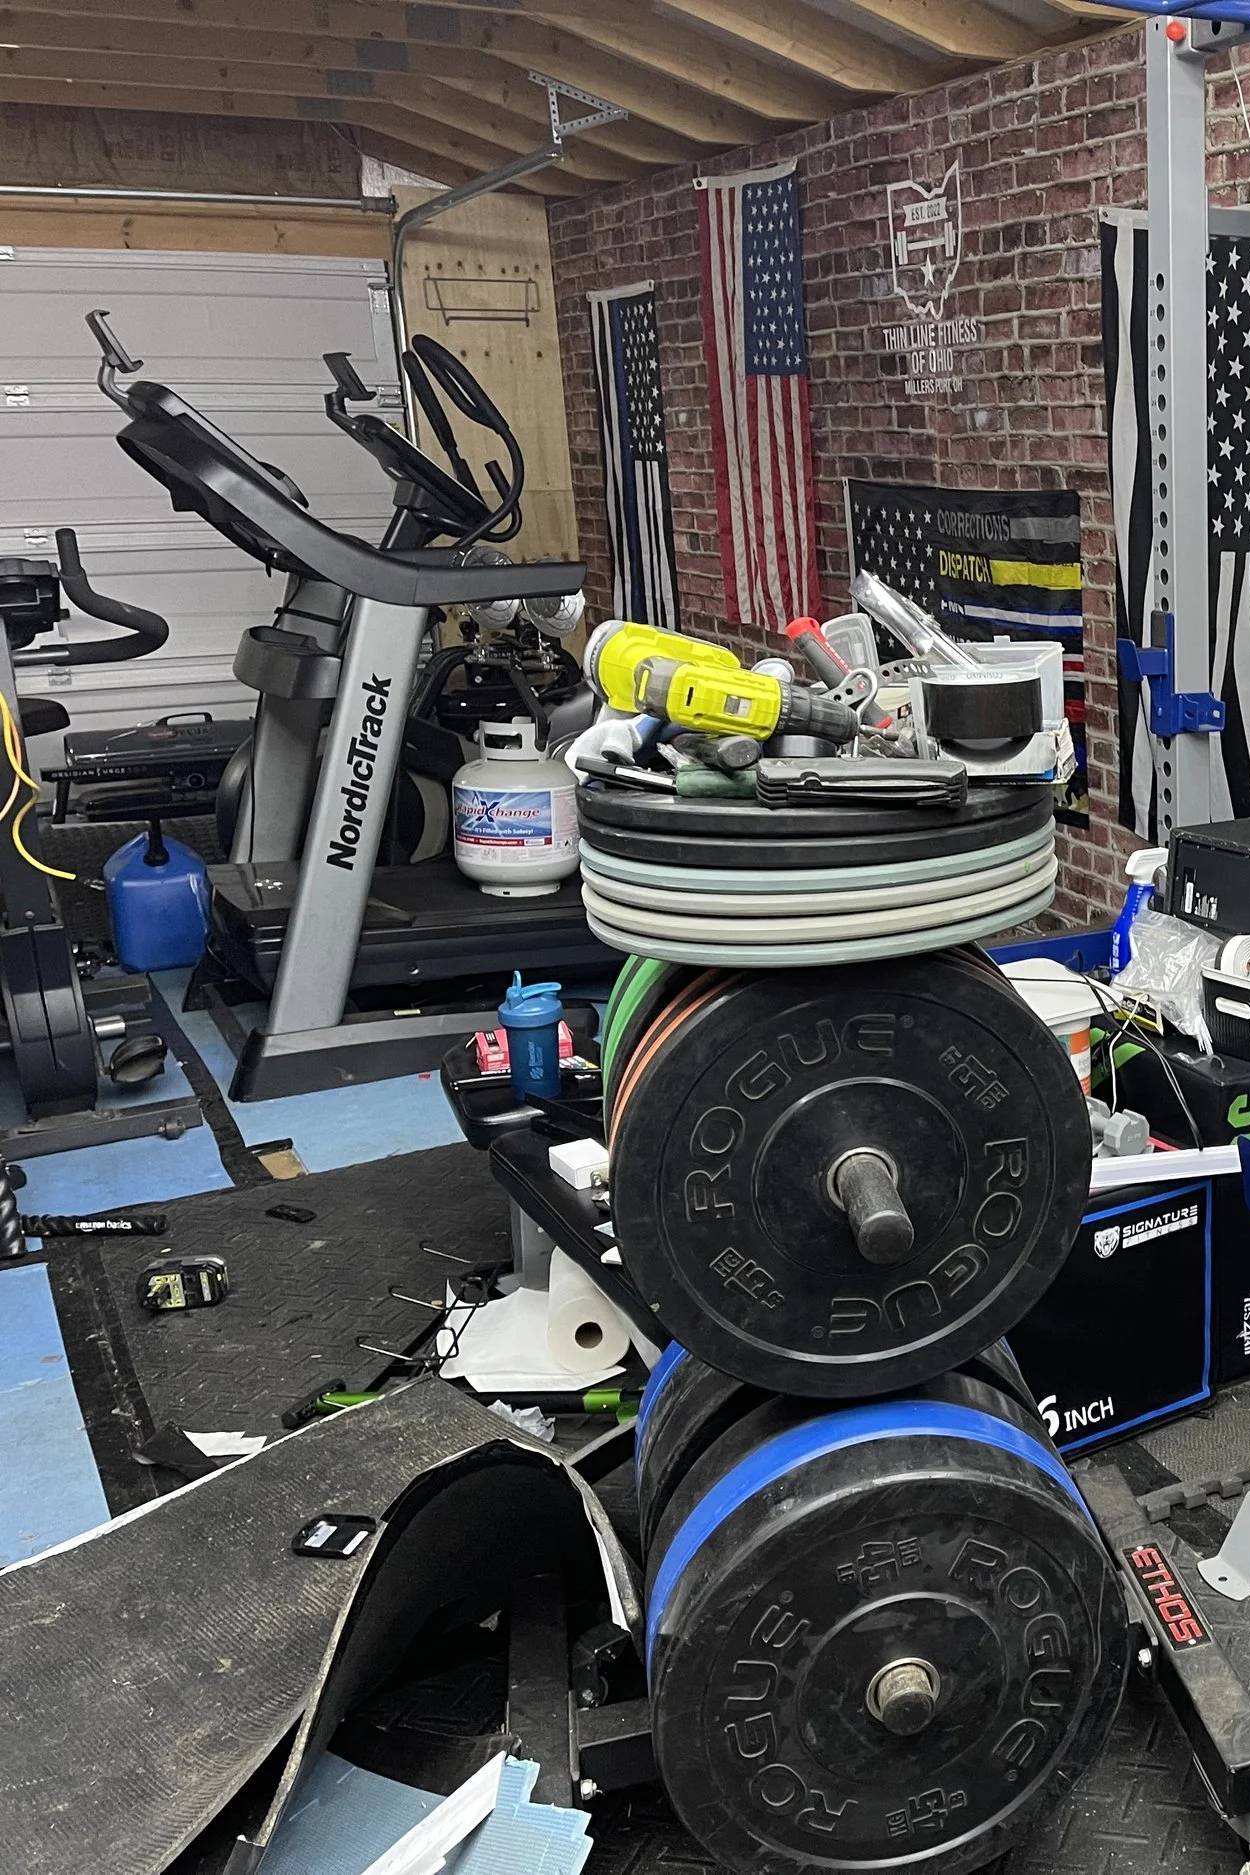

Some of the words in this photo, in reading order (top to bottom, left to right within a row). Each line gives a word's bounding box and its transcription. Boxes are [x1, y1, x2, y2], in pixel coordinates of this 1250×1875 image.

[926, 202, 941, 219] 2022
[883, 327, 907, 351] THIN
[910, 323, 936, 349] LINE
[938, 318, 977, 345] FITNESS
[911, 351, 926, 374] OF
[928, 348, 954, 374] OHIO
[937, 508, 1011, 542] CORRECTIONS
[939, 550, 992, 584] DISPATCH
[326, 672, 392, 871] NordicTrack
[682, 1013, 899, 1224] ROGUE
[106, 1220, 132, 1230] basics
[1122, 1204, 1198, 1238] SIGNATURE
[827, 1136, 1031, 1342] ROGUE
[1064, 1396, 1115, 1432] INCH
[1130, 1548, 1204, 1645] ETHOS
[946, 1537, 1071, 1768] ROGUE
[723, 1603, 859, 1832] ROGUE
